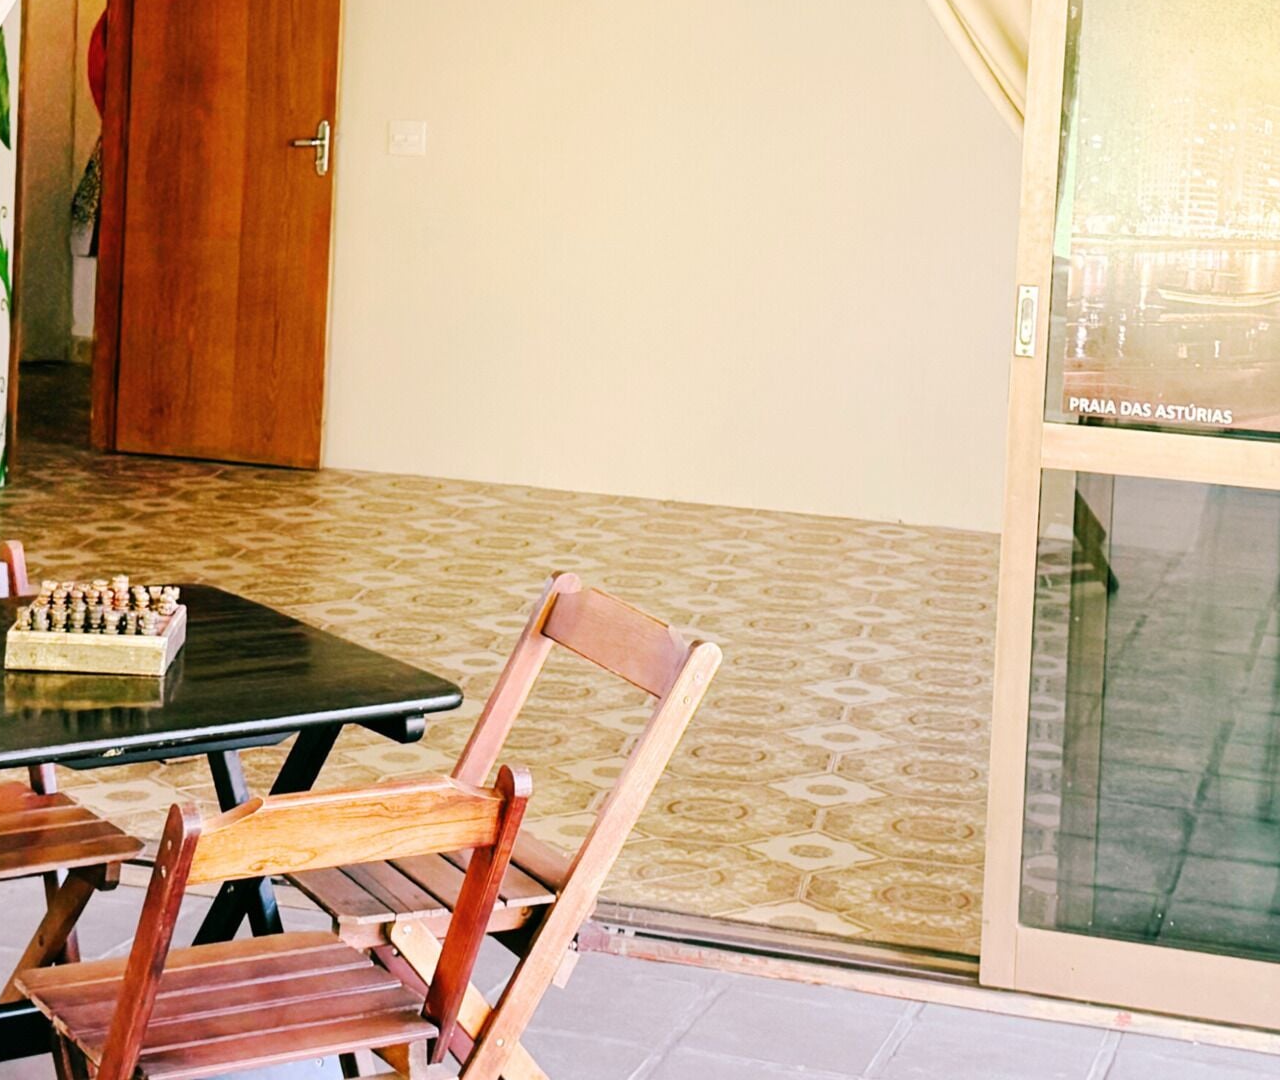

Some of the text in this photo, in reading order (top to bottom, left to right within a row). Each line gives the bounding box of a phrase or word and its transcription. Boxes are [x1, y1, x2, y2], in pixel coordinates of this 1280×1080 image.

[1069, 397, 1233, 424] PRAIA DAS ASTÚRIAS
